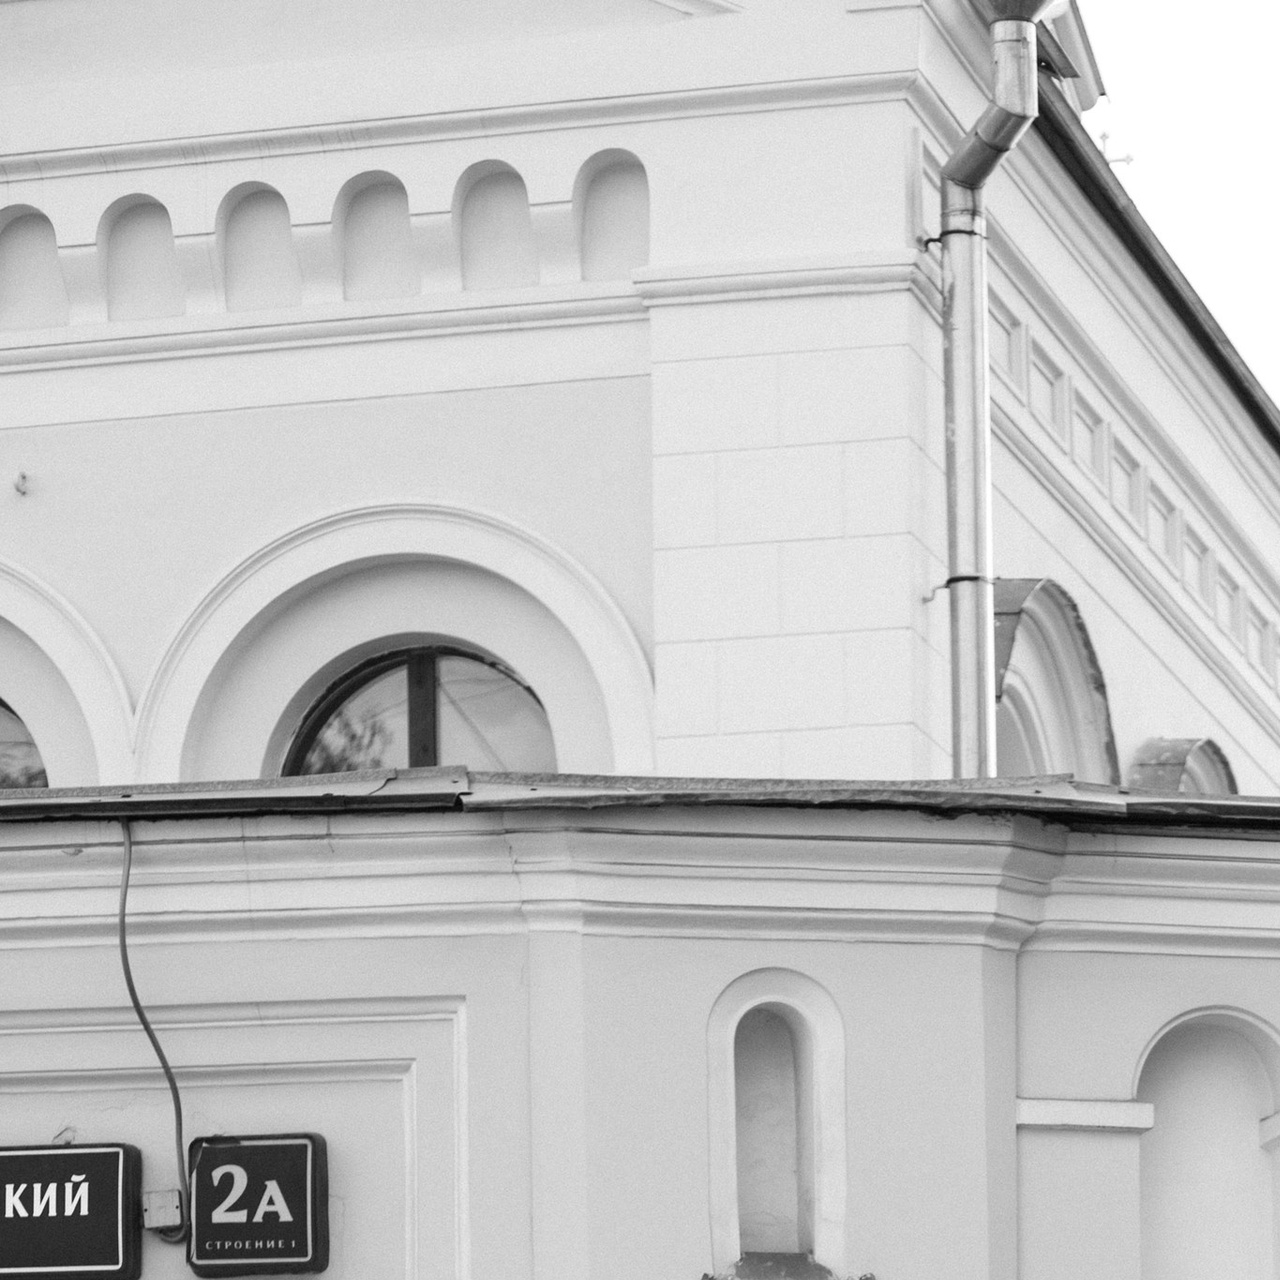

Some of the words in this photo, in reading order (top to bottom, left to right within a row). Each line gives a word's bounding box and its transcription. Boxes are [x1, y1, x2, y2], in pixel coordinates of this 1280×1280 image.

[4, 1174, 90, 1218] КИЙ
[210, 1163, 294, 1224] 2А
[204, 1239, 286, 1250] СТРОЕНИЕ
